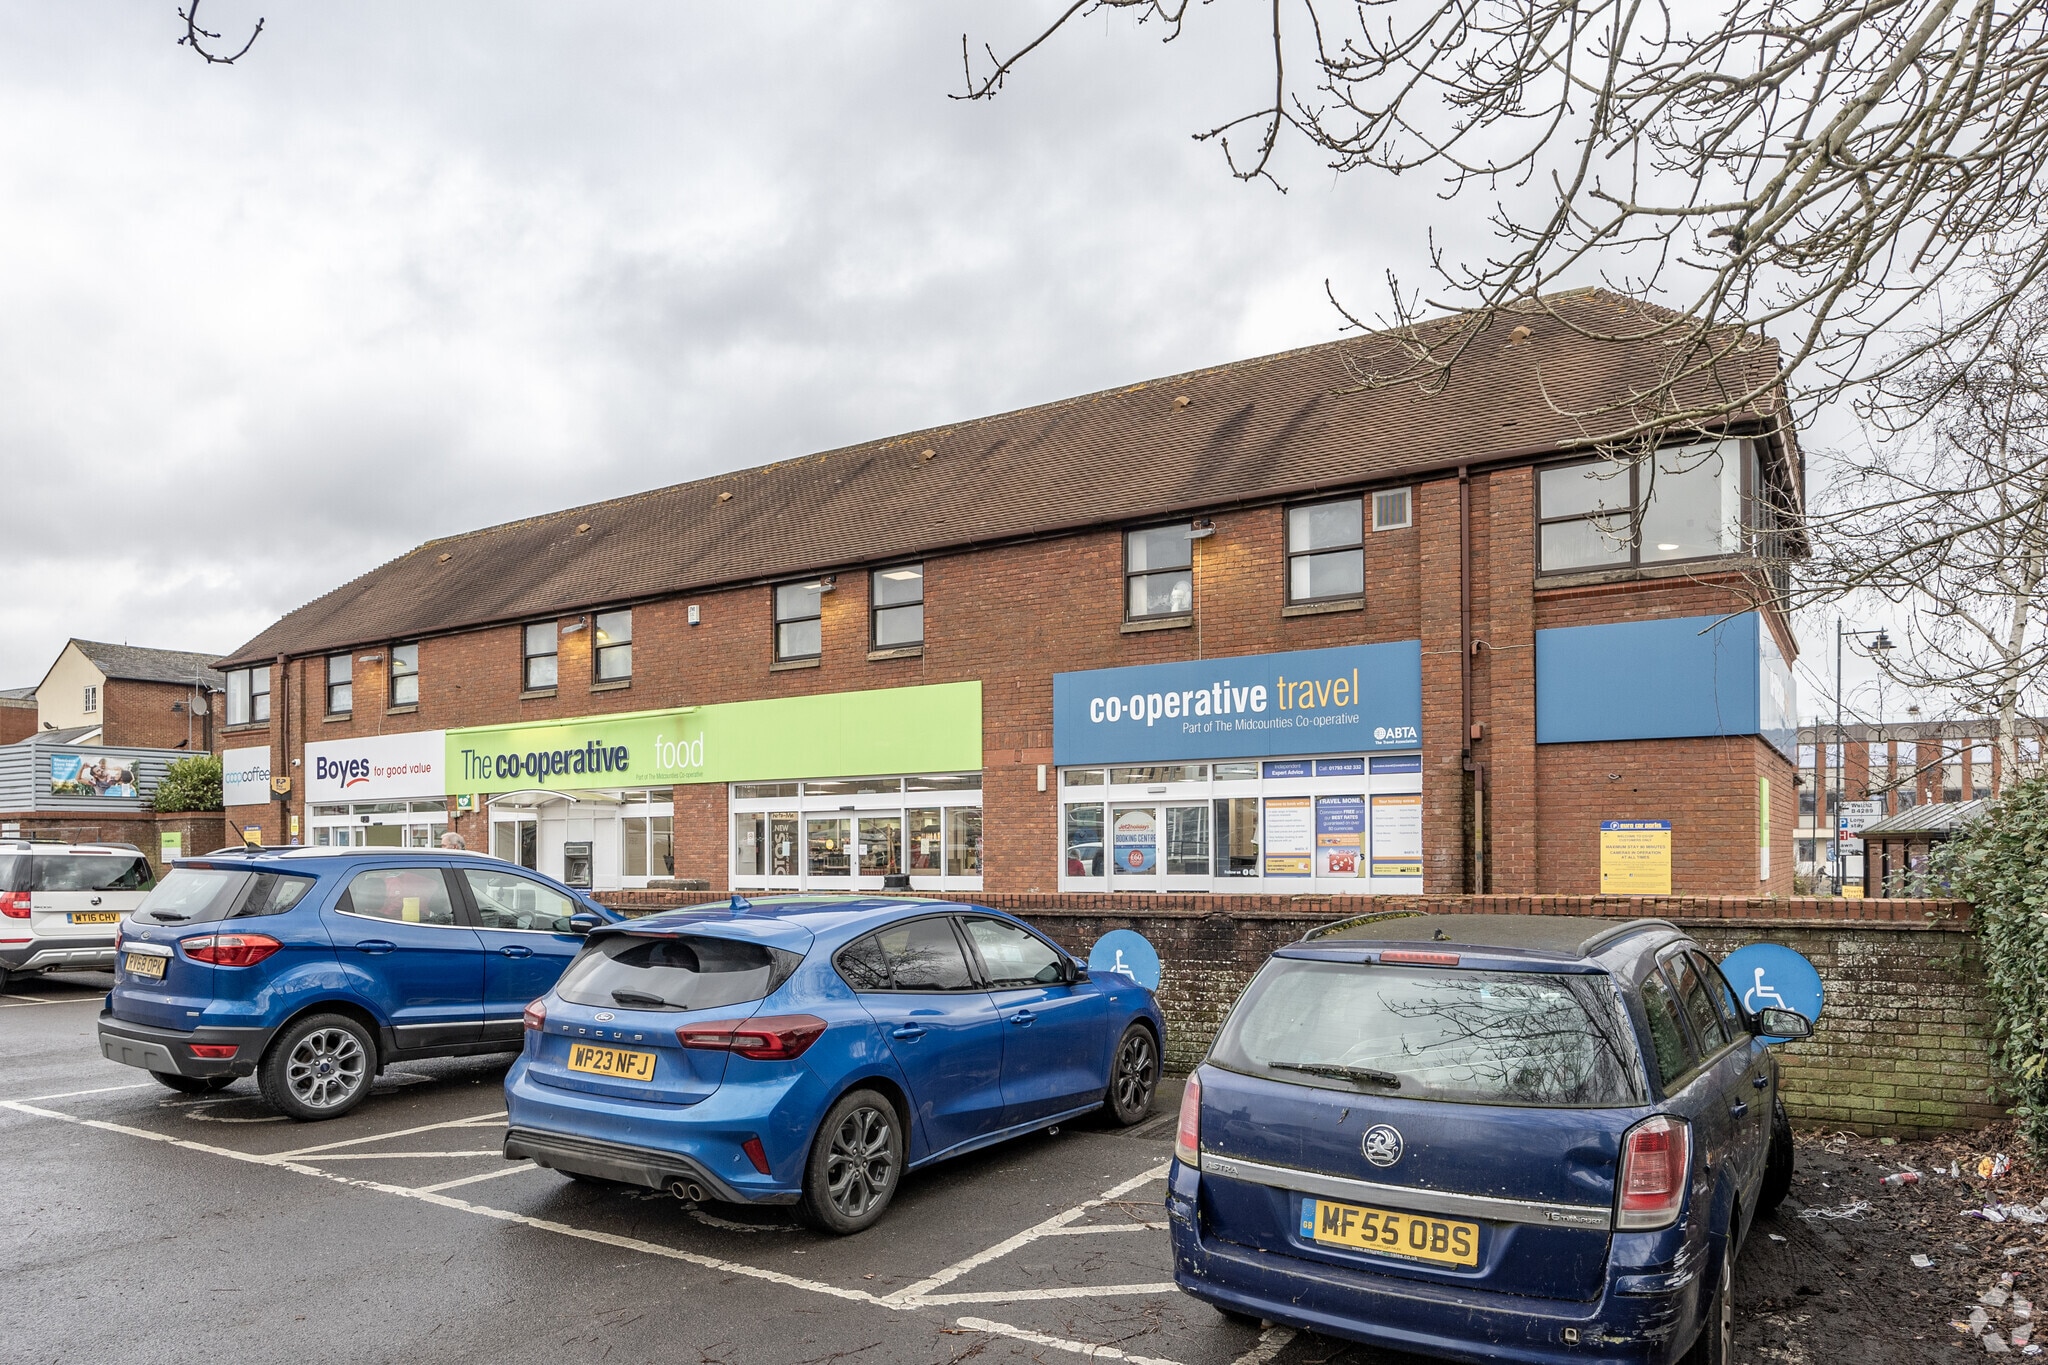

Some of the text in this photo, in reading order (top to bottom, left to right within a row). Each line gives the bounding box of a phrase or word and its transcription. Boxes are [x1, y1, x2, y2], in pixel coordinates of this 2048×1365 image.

[1090, 668, 1358, 727] co-operative travel
[1182, 713, 1359, 734] Part of The Midcounties Co-operative
[1386, 727, 1417, 739] ABTA
[655, 731, 704, 769] food
[461, 740, 629, 784] The co-operative
[317, 757, 431, 789] Boyes for good value
[1116, 834, 1156, 842] BOOKING CENTRE
[99, 913, 117, 921] CHV
[128, 955, 163, 974] RV68 OPK
[563, 1025, 643, 1041] FOCUS
[575, 1047, 648, 1075] WP23 NFJ
[1206, 1161, 1239, 1176] ASTRA
[1303, 1221, 1313, 1230] GB
[1322, 1205, 1471, 1257] MF55 OBS
